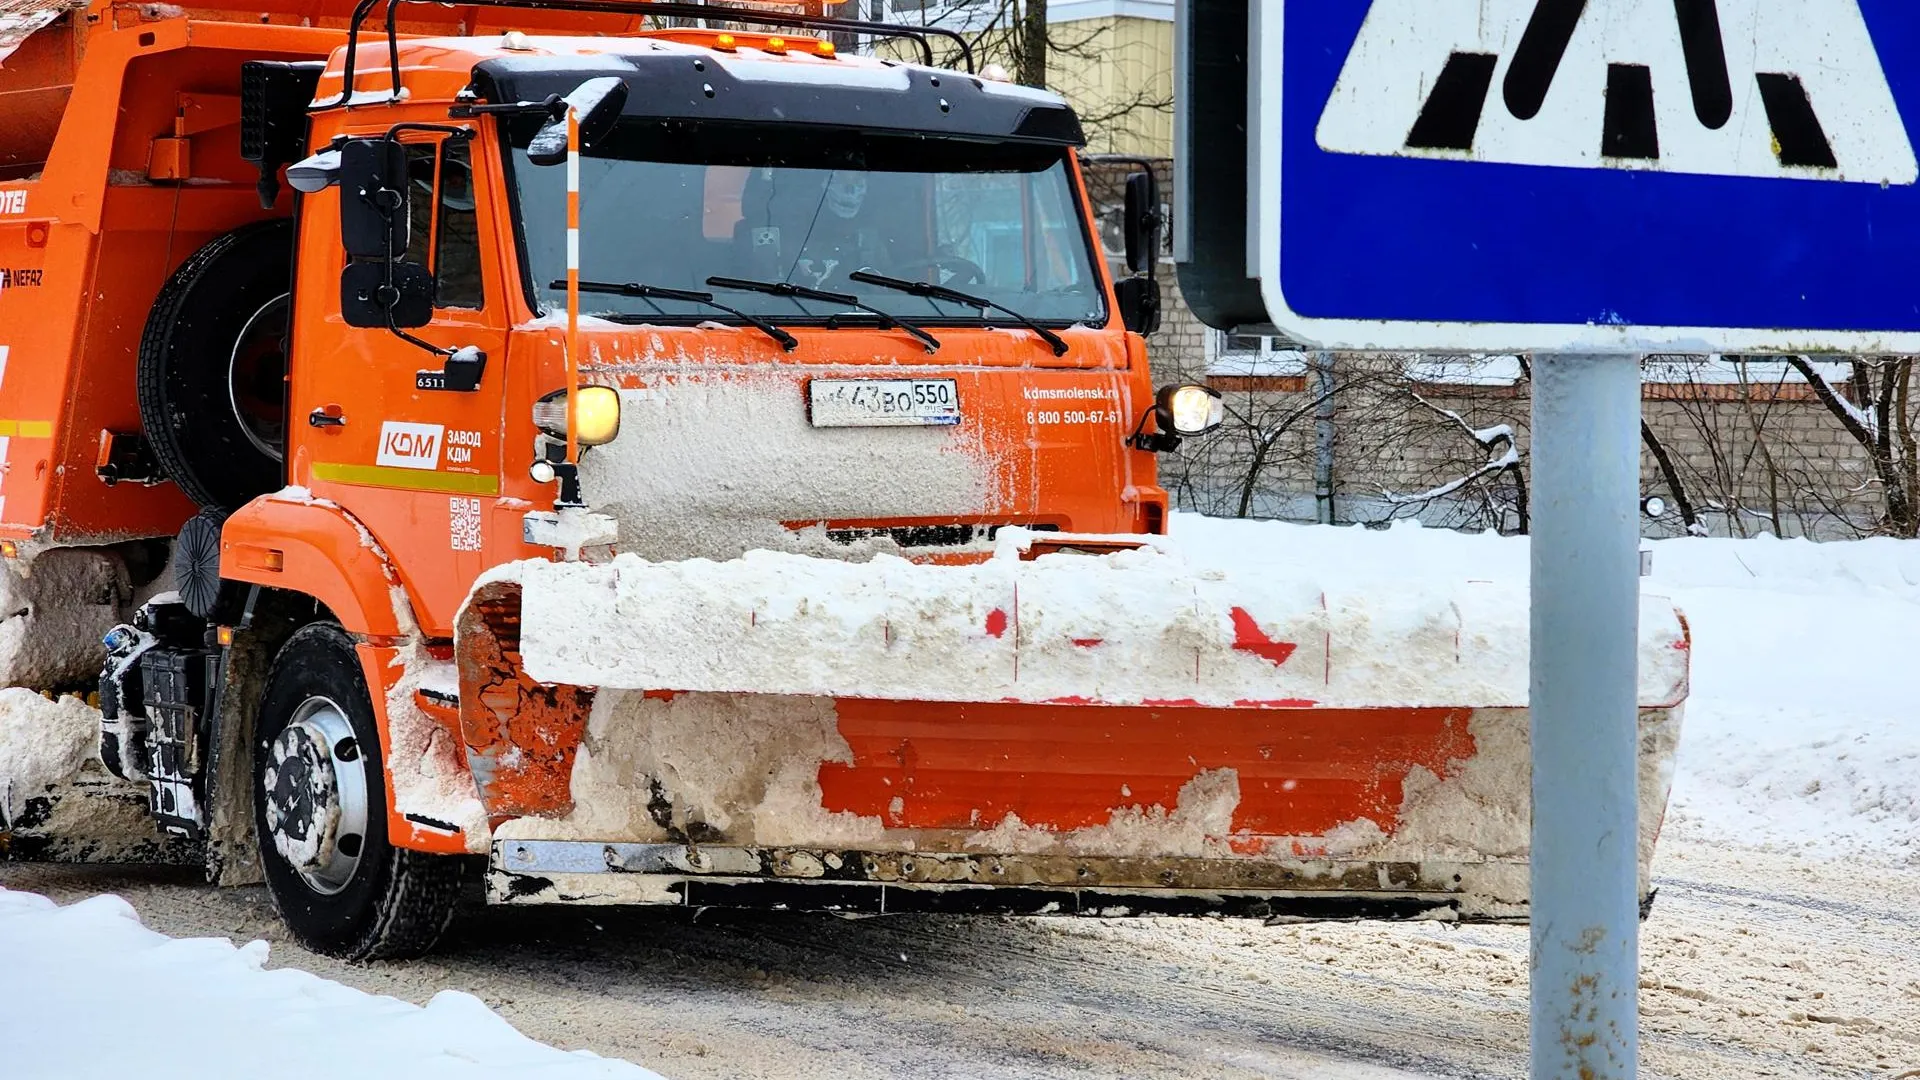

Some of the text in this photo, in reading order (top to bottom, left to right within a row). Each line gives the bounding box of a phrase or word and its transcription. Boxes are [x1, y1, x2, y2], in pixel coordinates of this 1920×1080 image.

[13, 269, 43, 287] NEFAZ
[417, 378, 445, 388] 6511
[914, 384, 949, 404] 550
[1023, 386, 1120, 400] kdmsmolensk.ru
[1026, 410, 1123, 424] 8 800 500-67-67
[447, 429, 481, 448] ЗАВОД
[447, 446, 471, 463] КДМ
